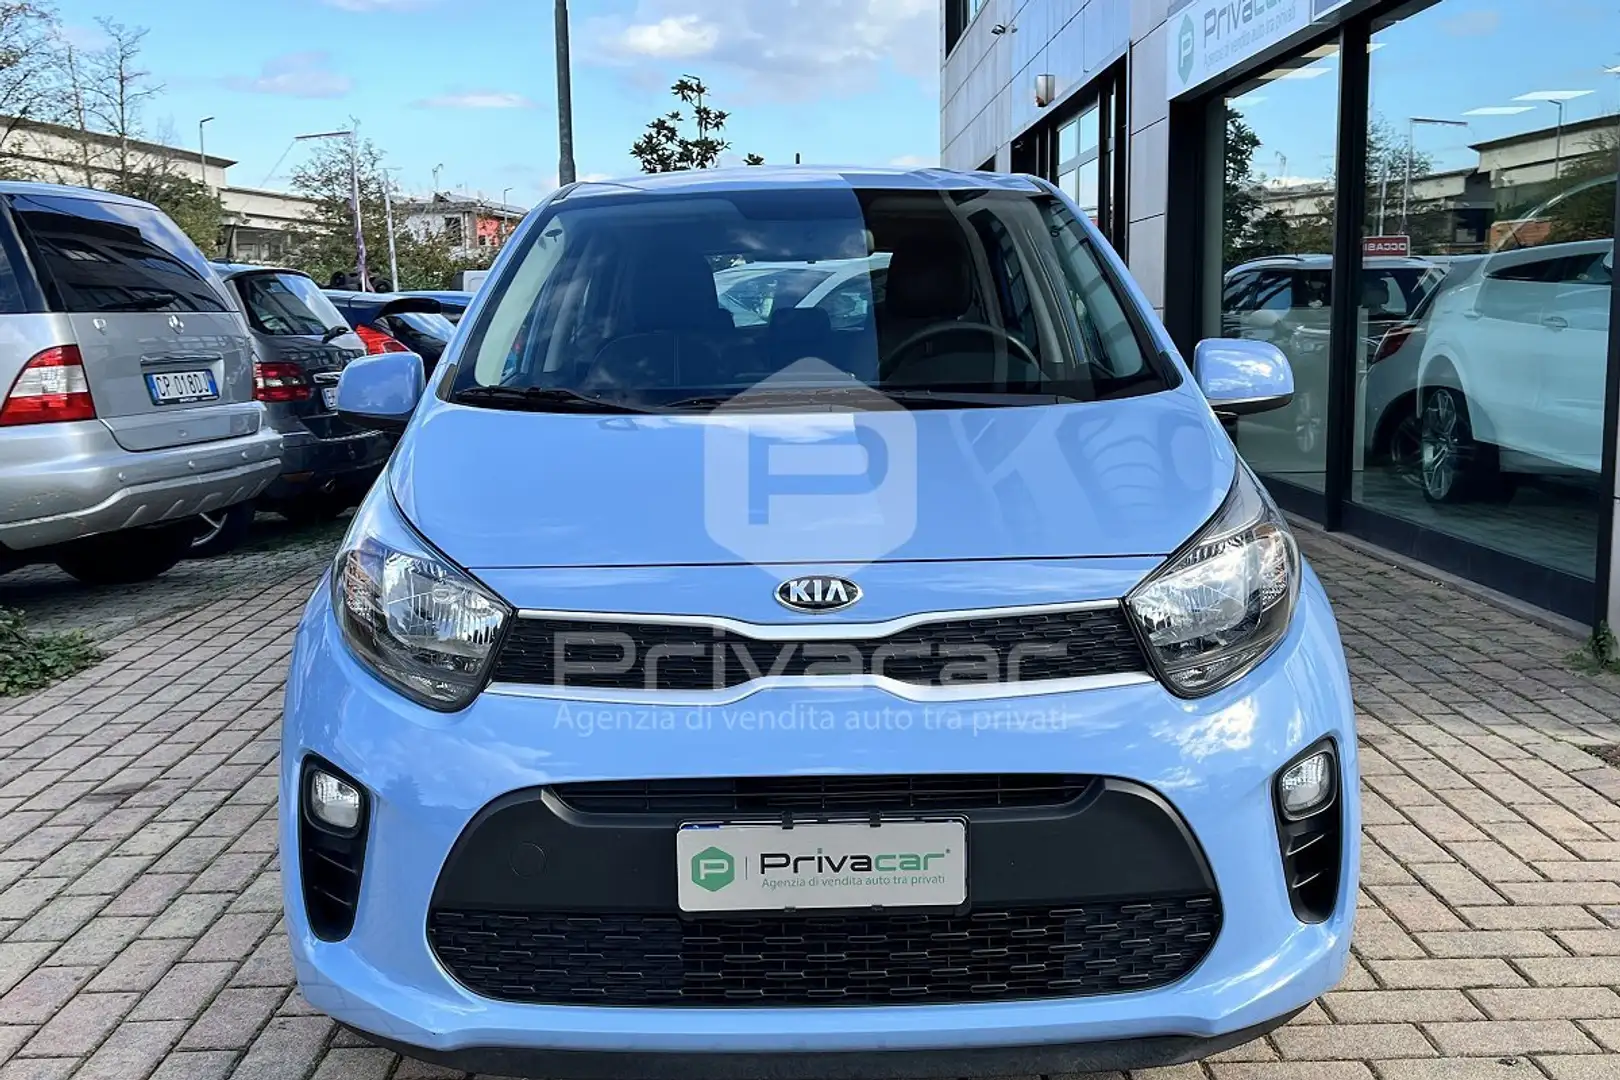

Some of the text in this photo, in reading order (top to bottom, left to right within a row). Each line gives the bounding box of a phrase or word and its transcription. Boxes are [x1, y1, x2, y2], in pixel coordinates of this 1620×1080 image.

[789, 579, 849, 602] KIA
[761, 874, 945, 891] Agenzia di vendita auto tra privati
